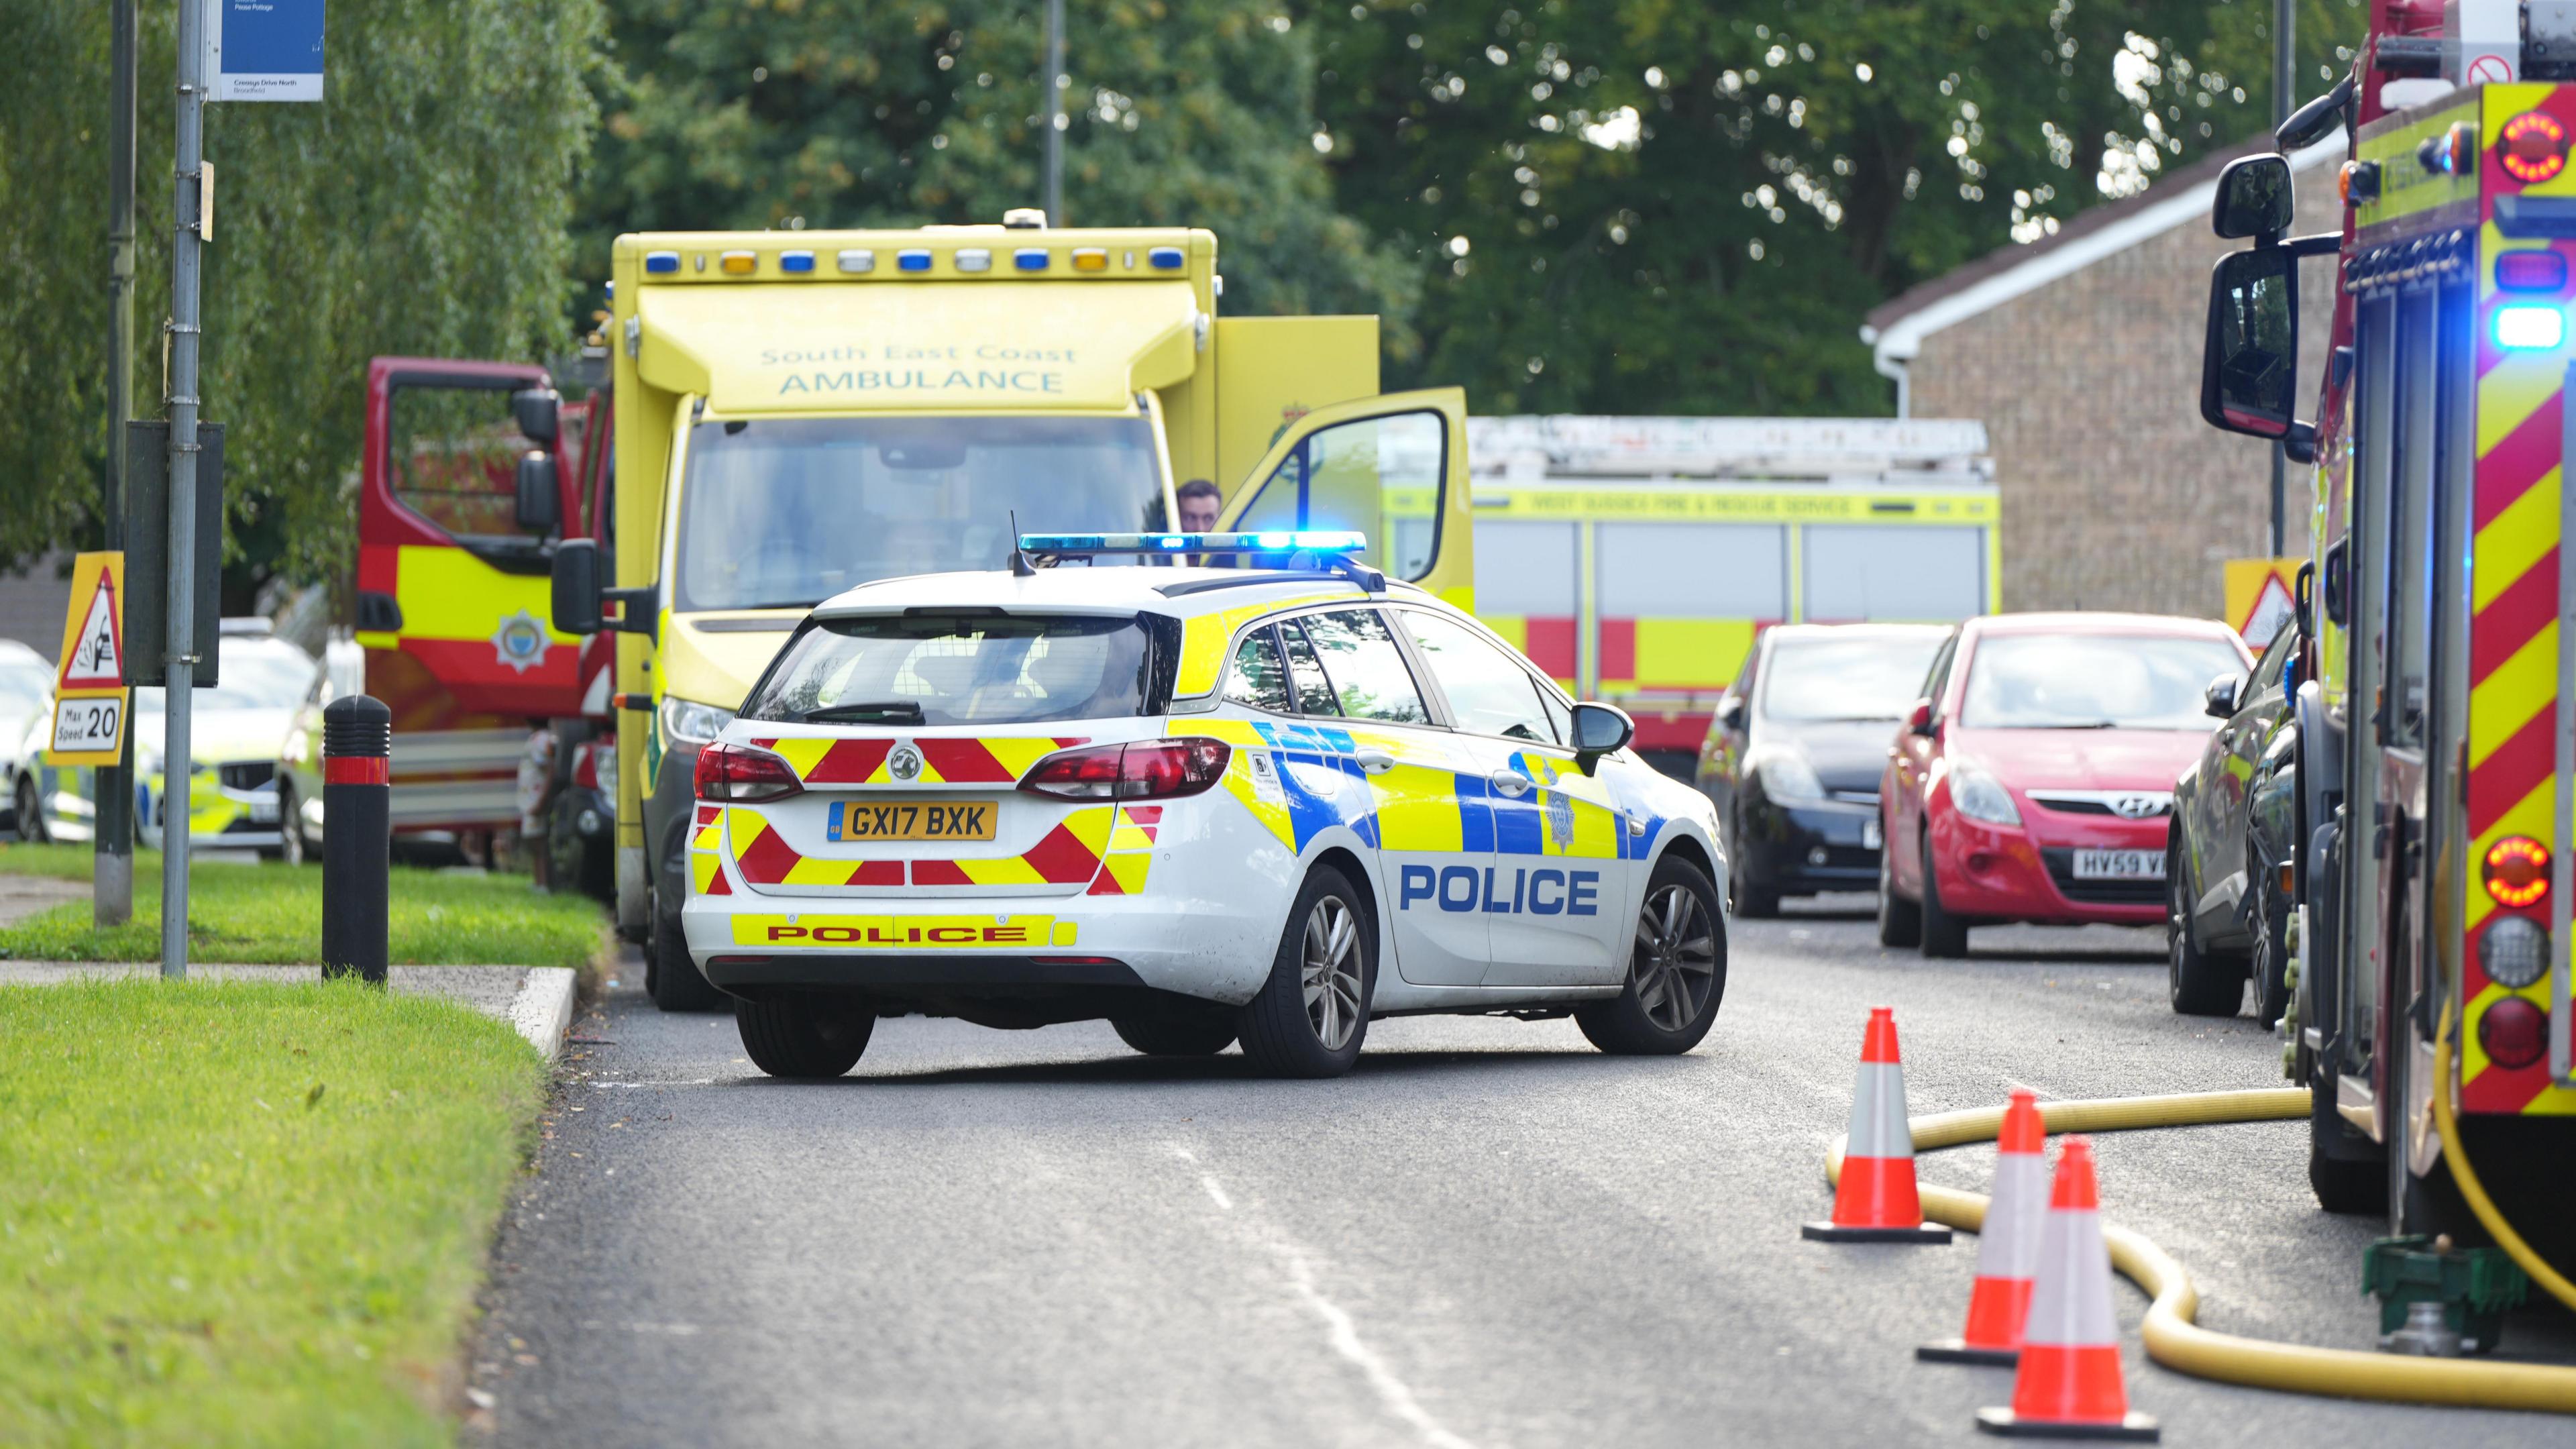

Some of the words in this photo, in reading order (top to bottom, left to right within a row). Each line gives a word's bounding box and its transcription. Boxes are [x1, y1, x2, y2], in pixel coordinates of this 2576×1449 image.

[252, 3, 273, 11] Pottage
[761, 345, 867, 366] South
[884, 345, 958, 360] East
[976, 344, 1077, 364] Coast
[779, 370, 1064, 394] AMBULANCE
[65, 708, 81, 722] Max
[87, 706, 115, 738] 20
[58, 727, 83, 742] Speed
[830, 825, 841, 834] GB
[852, 807, 918, 835] GX17
[926, 807, 985, 835] BXK
[2084, 852, 2139, 873] HV59
[1400, 864, 1599, 916] POLICE
[767, 926, 1026, 943] POLICE
